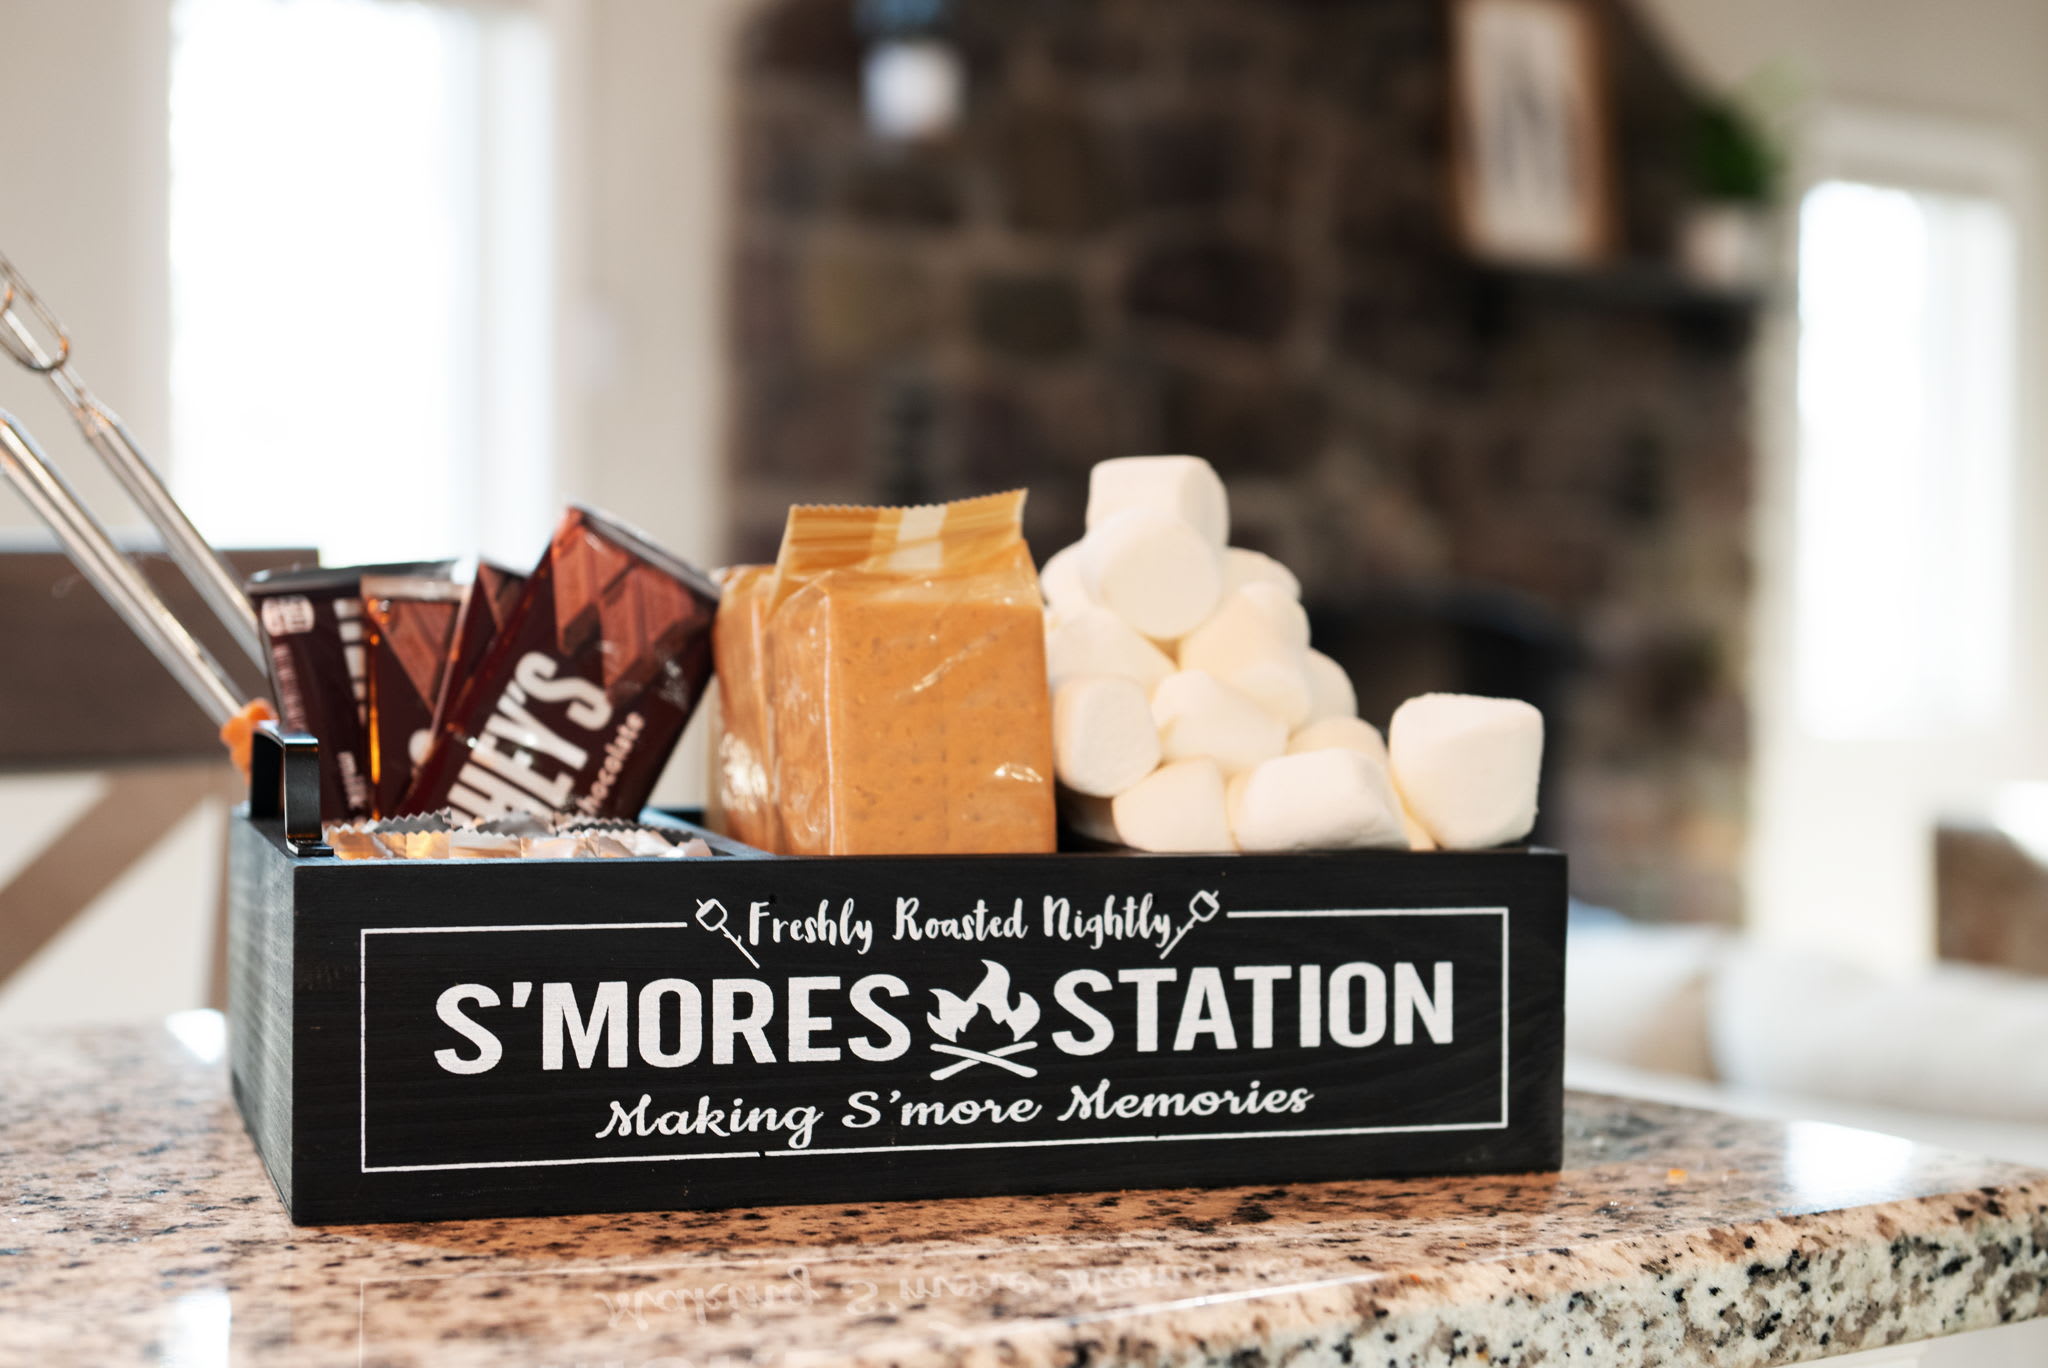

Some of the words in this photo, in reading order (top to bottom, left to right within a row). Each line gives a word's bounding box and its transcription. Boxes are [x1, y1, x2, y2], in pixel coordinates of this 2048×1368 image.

[447, 652, 613, 832] HEY'S
[575, 712, 645, 817] hocolate
[748, 897, 874, 955] Freshly
[891, 896, 1029, 943] Roasted
[1042, 892, 1172, 951] Nightly
[433, 973, 914, 1075] S'MORES
[1051, 961, 1454, 1057] STATION
[594, 1093, 825, 1150] Making
[841, 1089, 1043, 1129] S'more
[1056, 1077, 1316, 1123] Memories
